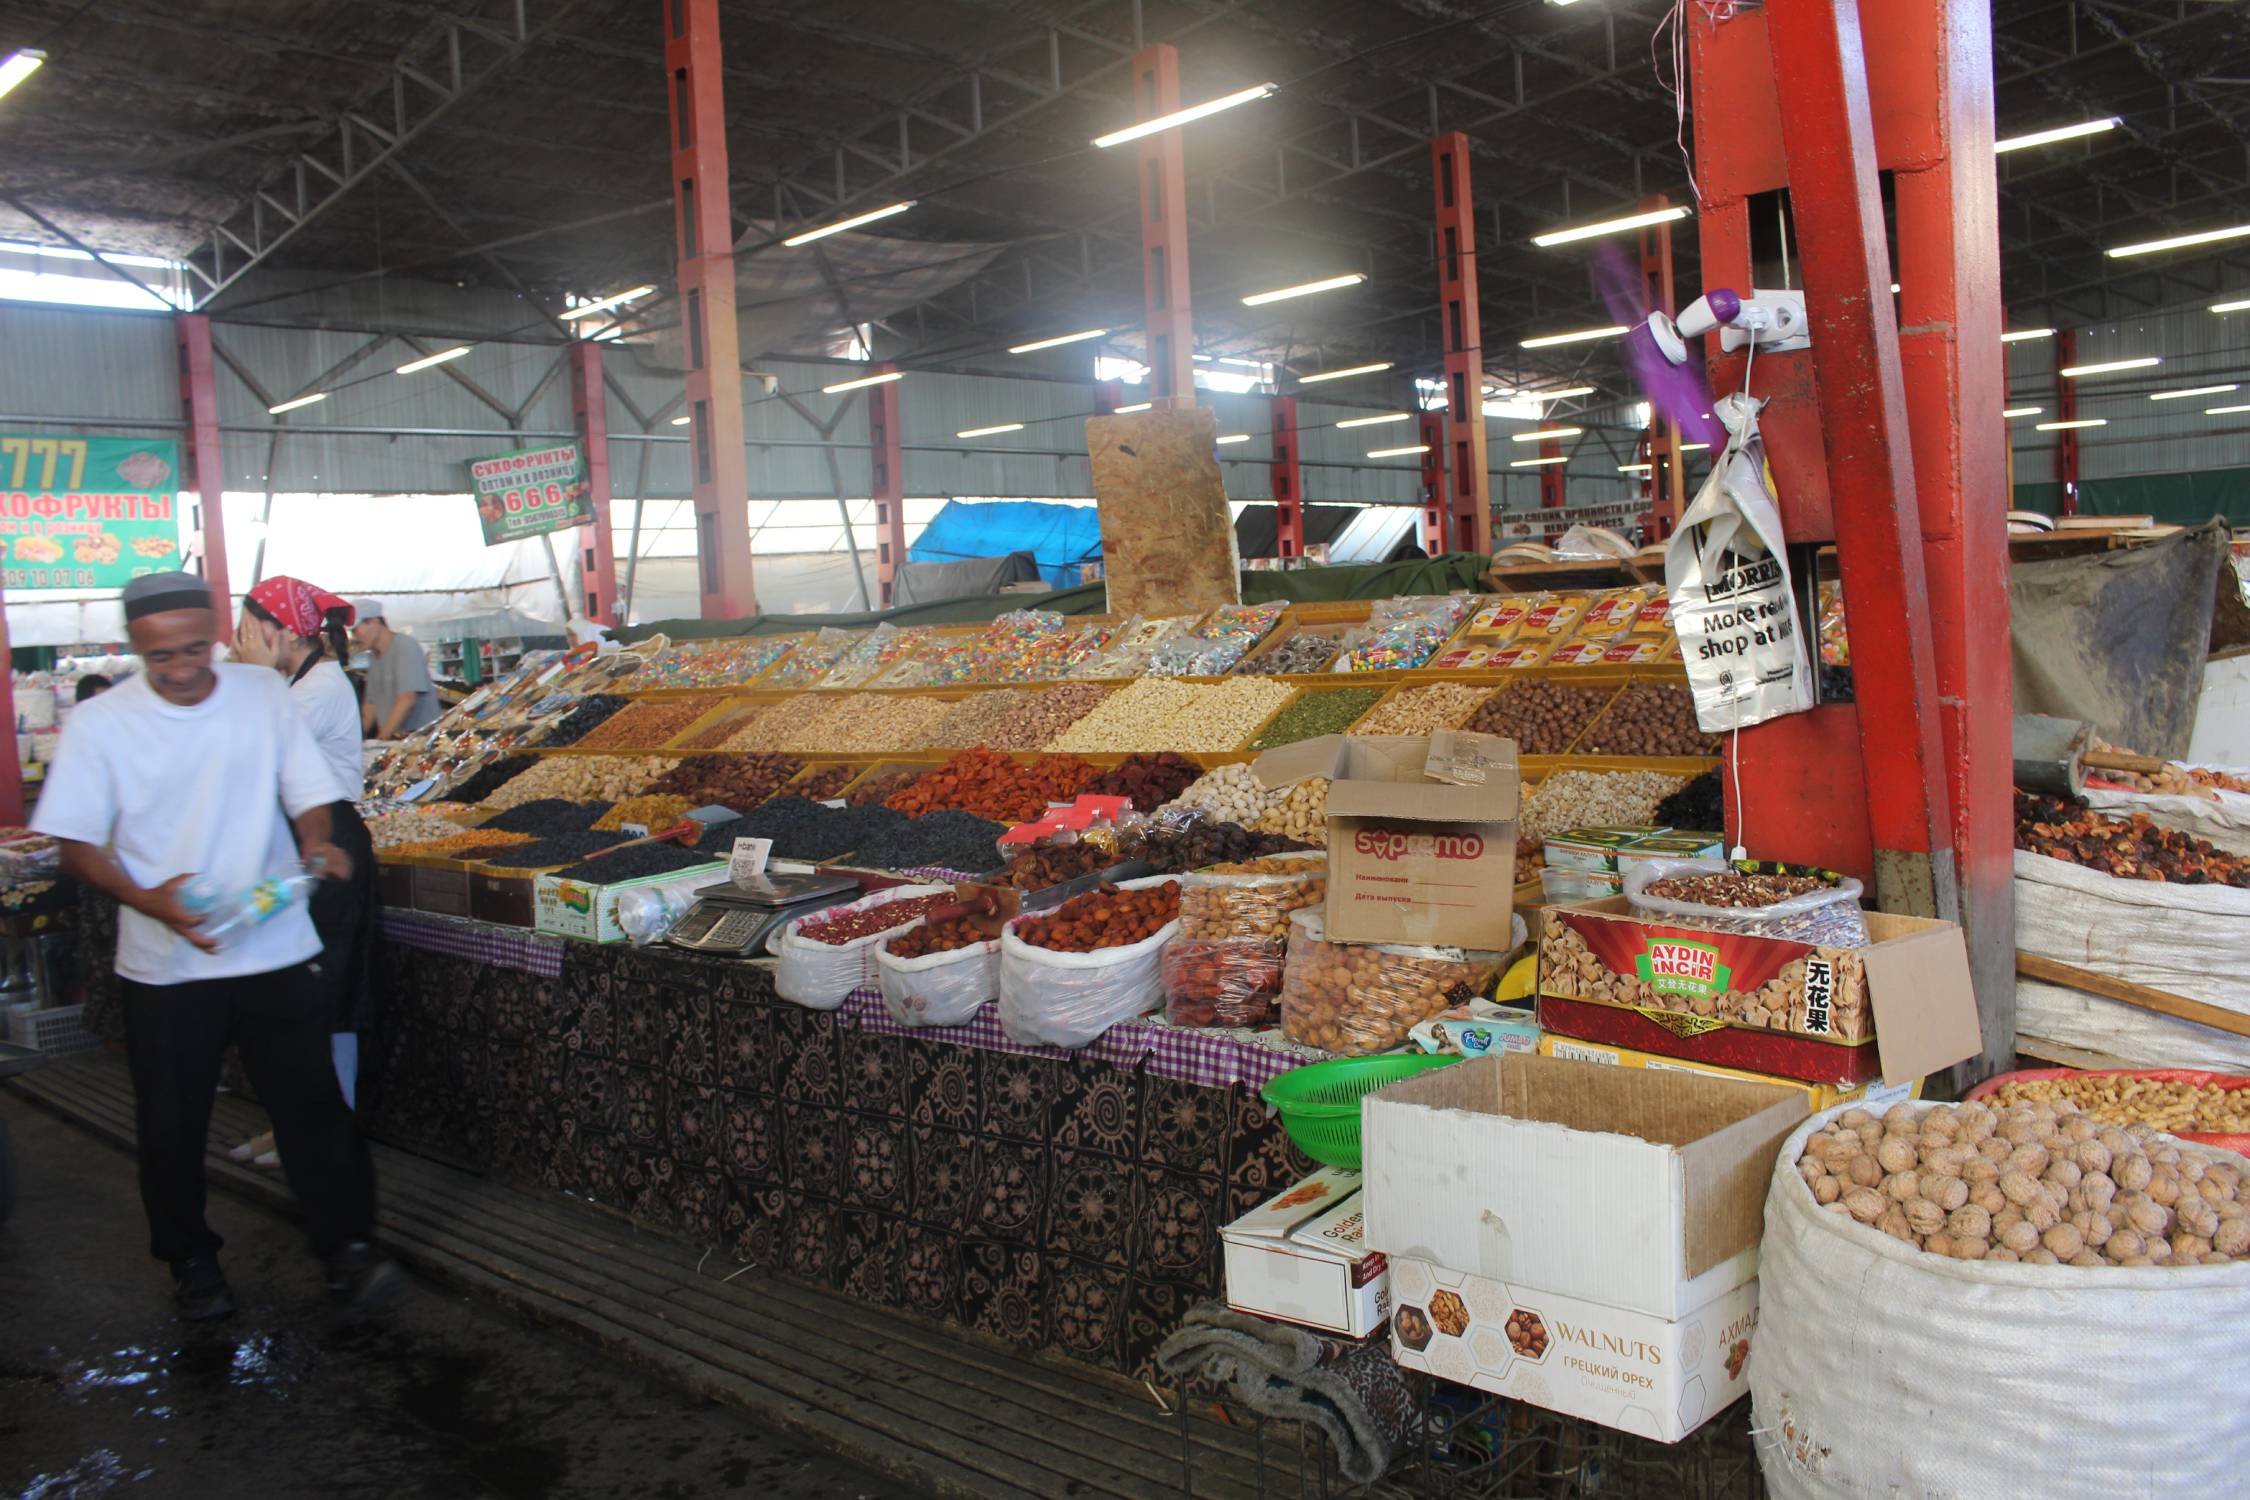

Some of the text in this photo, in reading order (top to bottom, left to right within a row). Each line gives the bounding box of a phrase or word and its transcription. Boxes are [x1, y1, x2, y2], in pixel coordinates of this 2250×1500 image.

[474, 446, 576, 478] СУХОФРУКТЫ
[505, 484, 562, 512] 666
[1704, 604, 1756, 634] More
[1698, 635, 1749, 660] shop
[1755, 624, 1775, 646] at
[1355, 892, 1375, 902] Дата
[1652, 945, 1714, 967] AYDIN
[1806, 961, 1830, 1033] 无花果
[1556, 1320, 1662, 1365] WALNUTS
[1563, 1355, 1654, 1390] ГРЕЦКИЙ ОРЕХ
